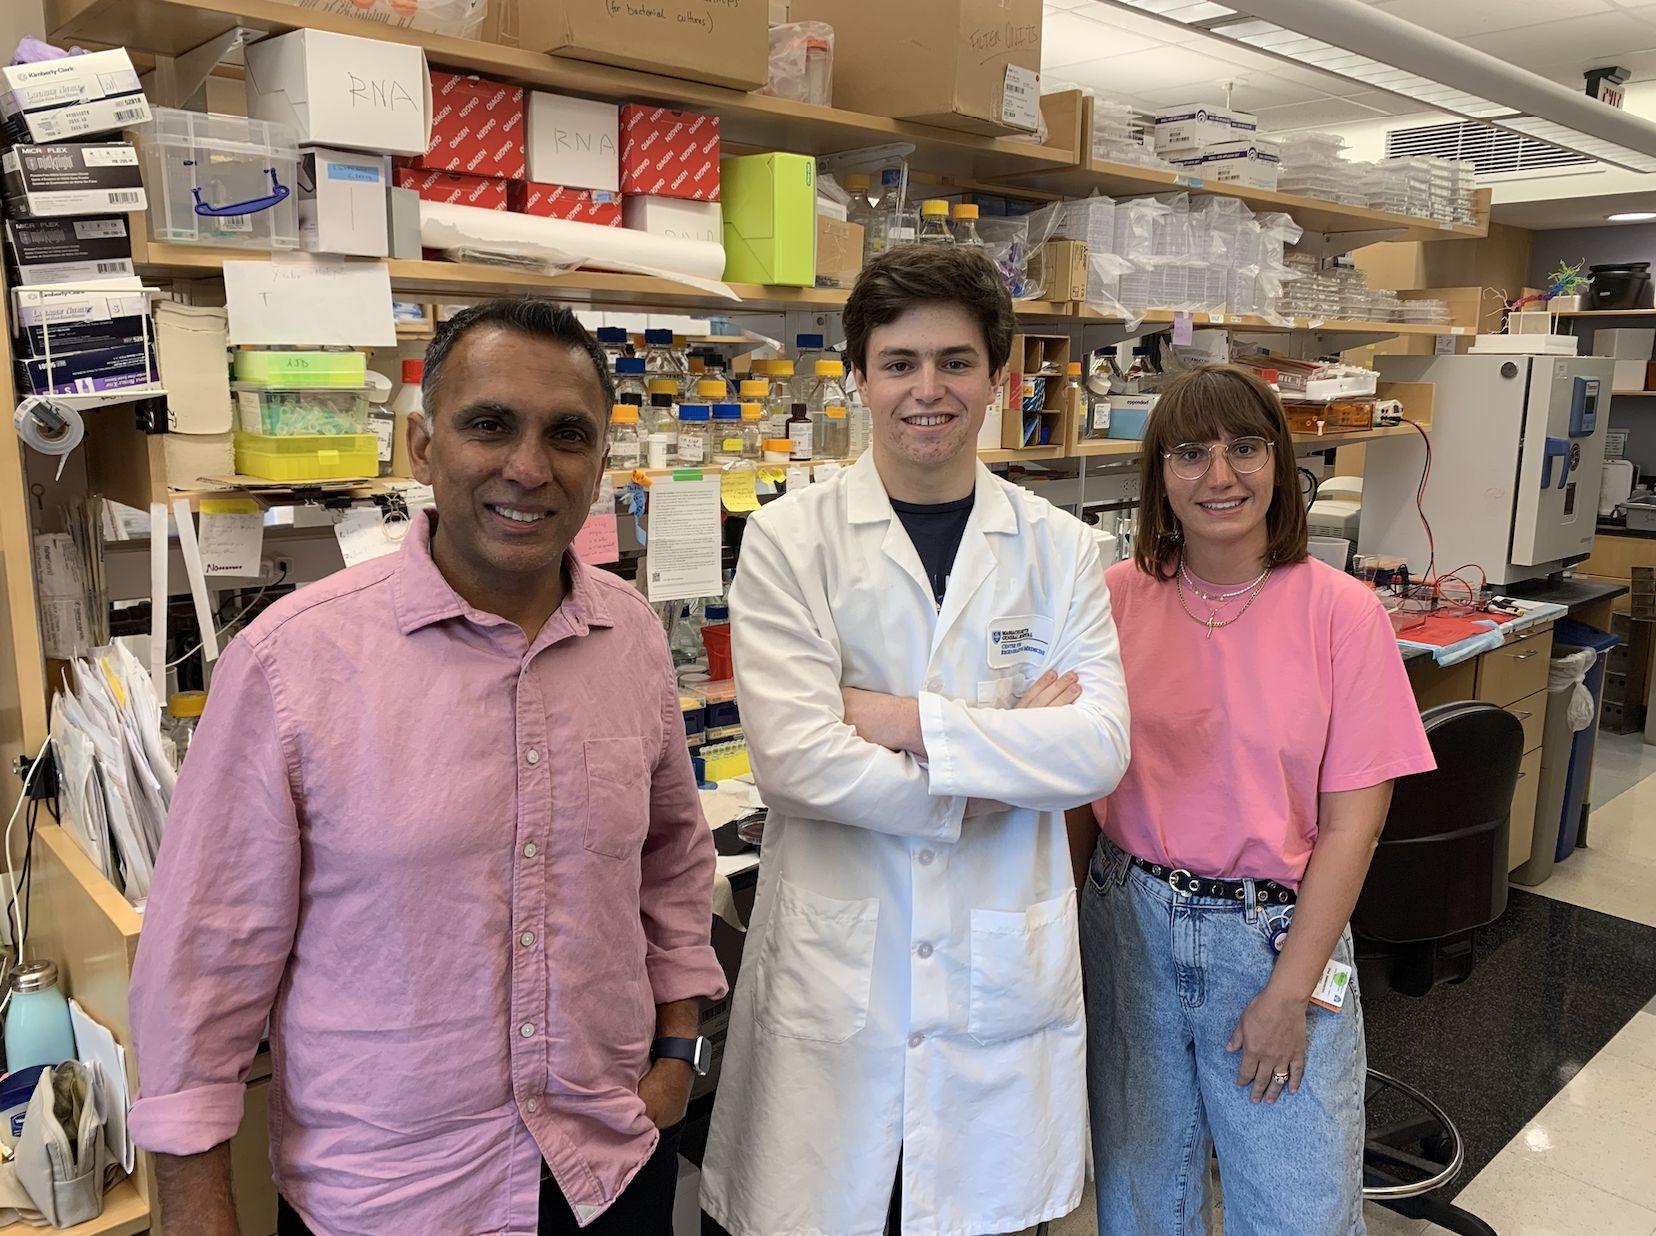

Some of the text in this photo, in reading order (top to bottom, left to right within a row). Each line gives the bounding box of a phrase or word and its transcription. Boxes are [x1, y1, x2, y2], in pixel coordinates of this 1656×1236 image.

[347, 71, 419, 112] RNA
[485, 88, 506, 111] QIAGEN
[458, 96, 479, 118] QIAGEN
[476, 118, 497, 140] QIAGEN
[502, 111, 522, 132] QIAGEN
[665, 122, 683, 143] QIAGEN
[688, 115, 706, 135] QIAGEN
[449, 125, 470, 149] QIAGEN
[554, 127, 616, 155] RNA
[641, 129, 660, 151] QIAGEN
[702, 133, 720, 154] QIAGEN
[467, 148, 488, 171] QIAGEN
[493, 139, 513, 162] QIAGEN
[656, 149, 674, 171] QIAGEN
[679, 141, 698, 163] QIAGEN
[631, 158, 650, 180] QIAGEN
[670, 169, 689, 191] QIAGEN
[693, 161, 712, 183] QIAGEN
[401, 176, 415, 191] GEN
[469, 180, 489, 202] QIAGEN
